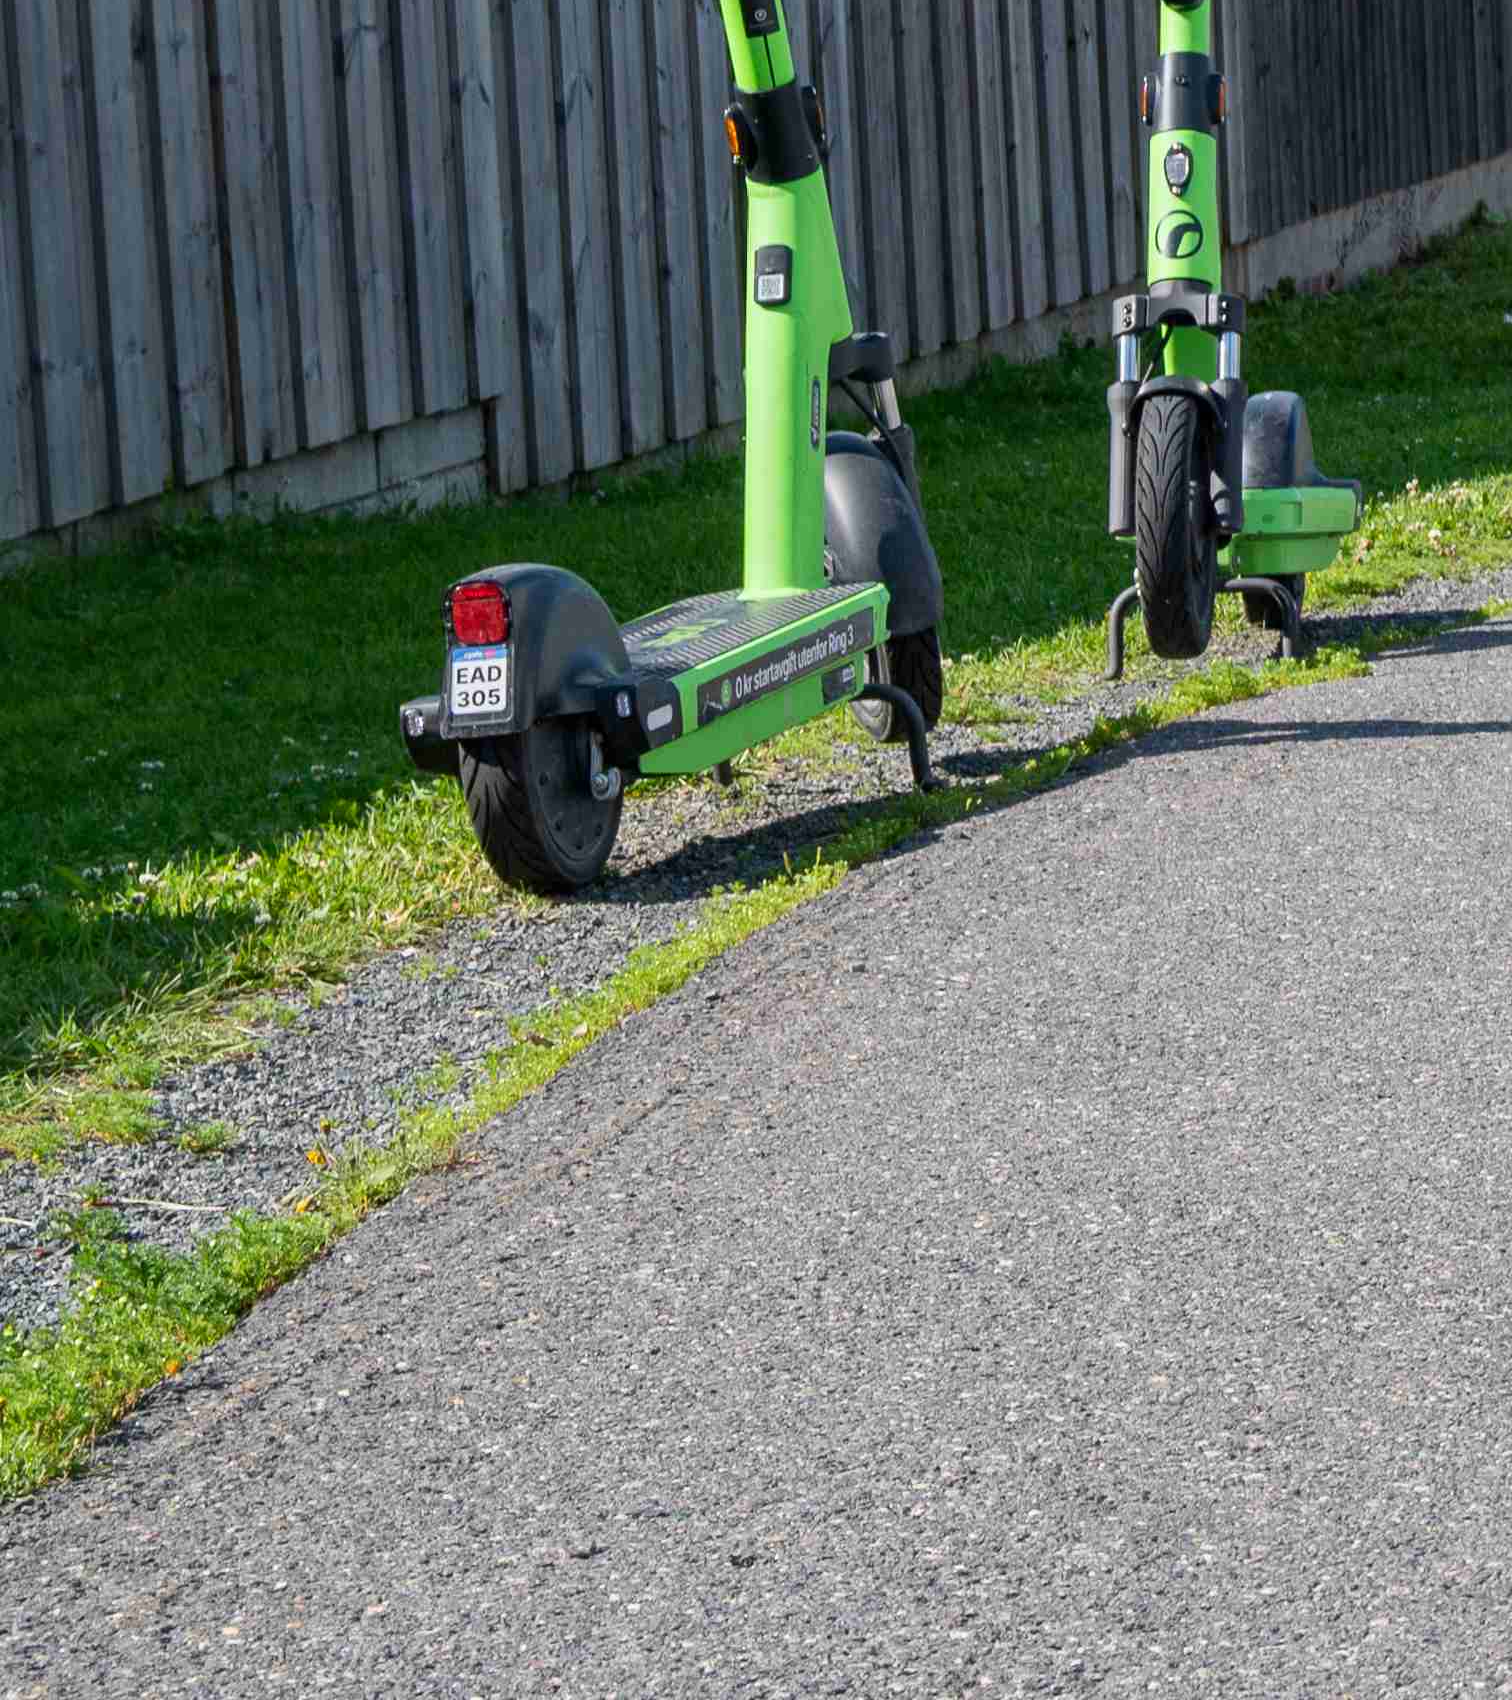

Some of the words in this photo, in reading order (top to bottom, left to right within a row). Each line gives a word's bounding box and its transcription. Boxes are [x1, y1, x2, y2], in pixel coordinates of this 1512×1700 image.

[735, 676, 743, 699] 0
[743, 672, 753, 697] kr
[753, 650, 798, 690] startavgift
[798, 638, 829, 669] utenfor
[828, 630, 847, 654] Ring
[847, 623, 854, 645] 3
[456, 665, 502, 685] EAD
[457, 688, 501, 708] 305
